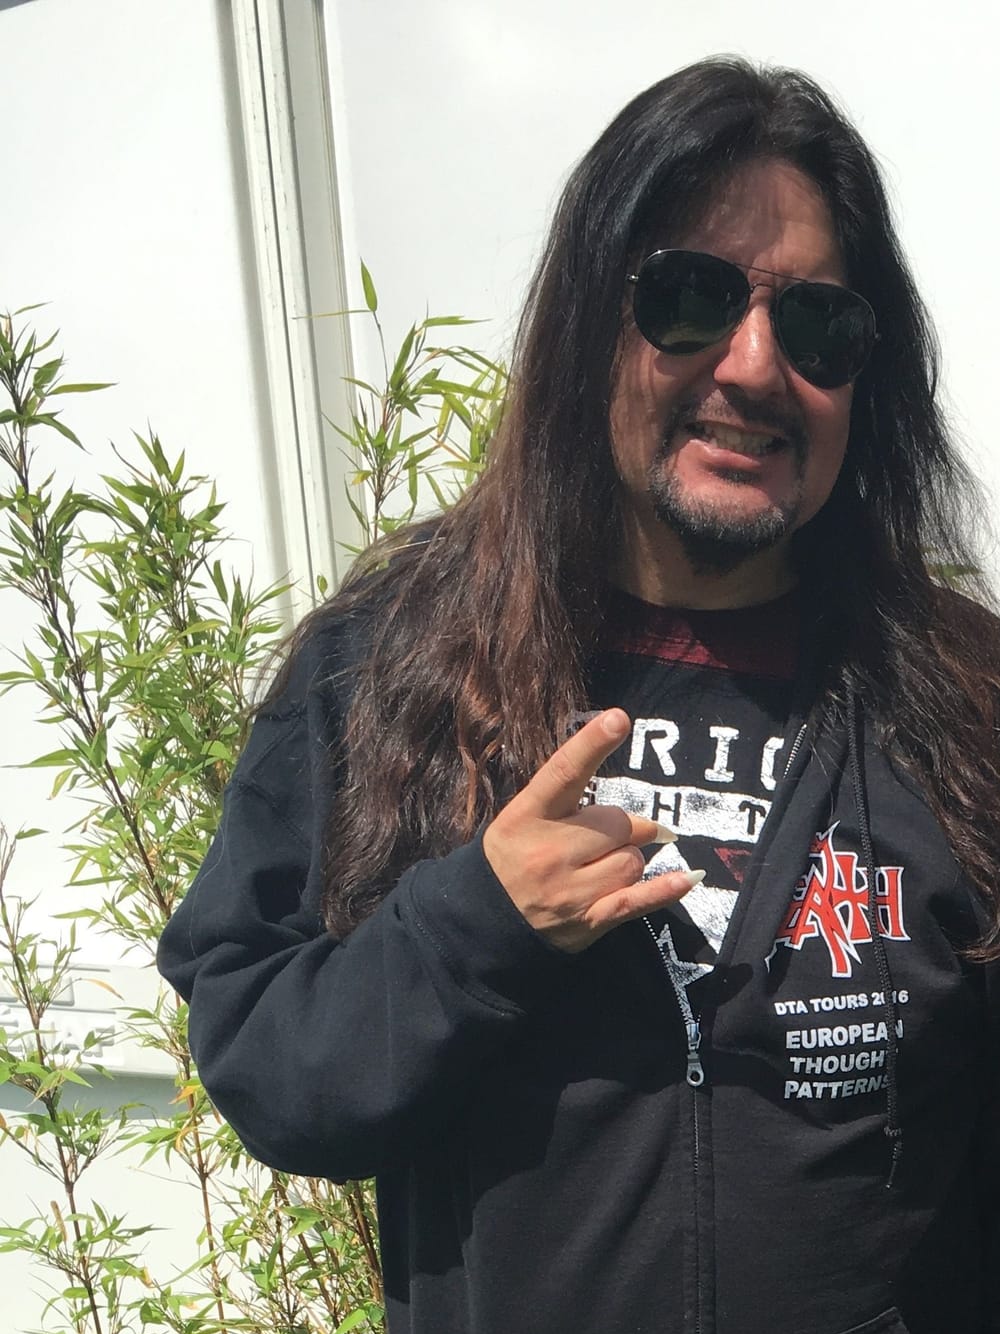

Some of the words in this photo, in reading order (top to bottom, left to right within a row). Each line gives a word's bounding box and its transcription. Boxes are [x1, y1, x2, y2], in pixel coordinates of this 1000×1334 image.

[774, 1000, 808, 1016] DTA
[810, 993, 869, 1012] TOURS
[789, 1047, 899, 1075] THOUGH
[784, 1074, 890, 1099] PATTERNS
